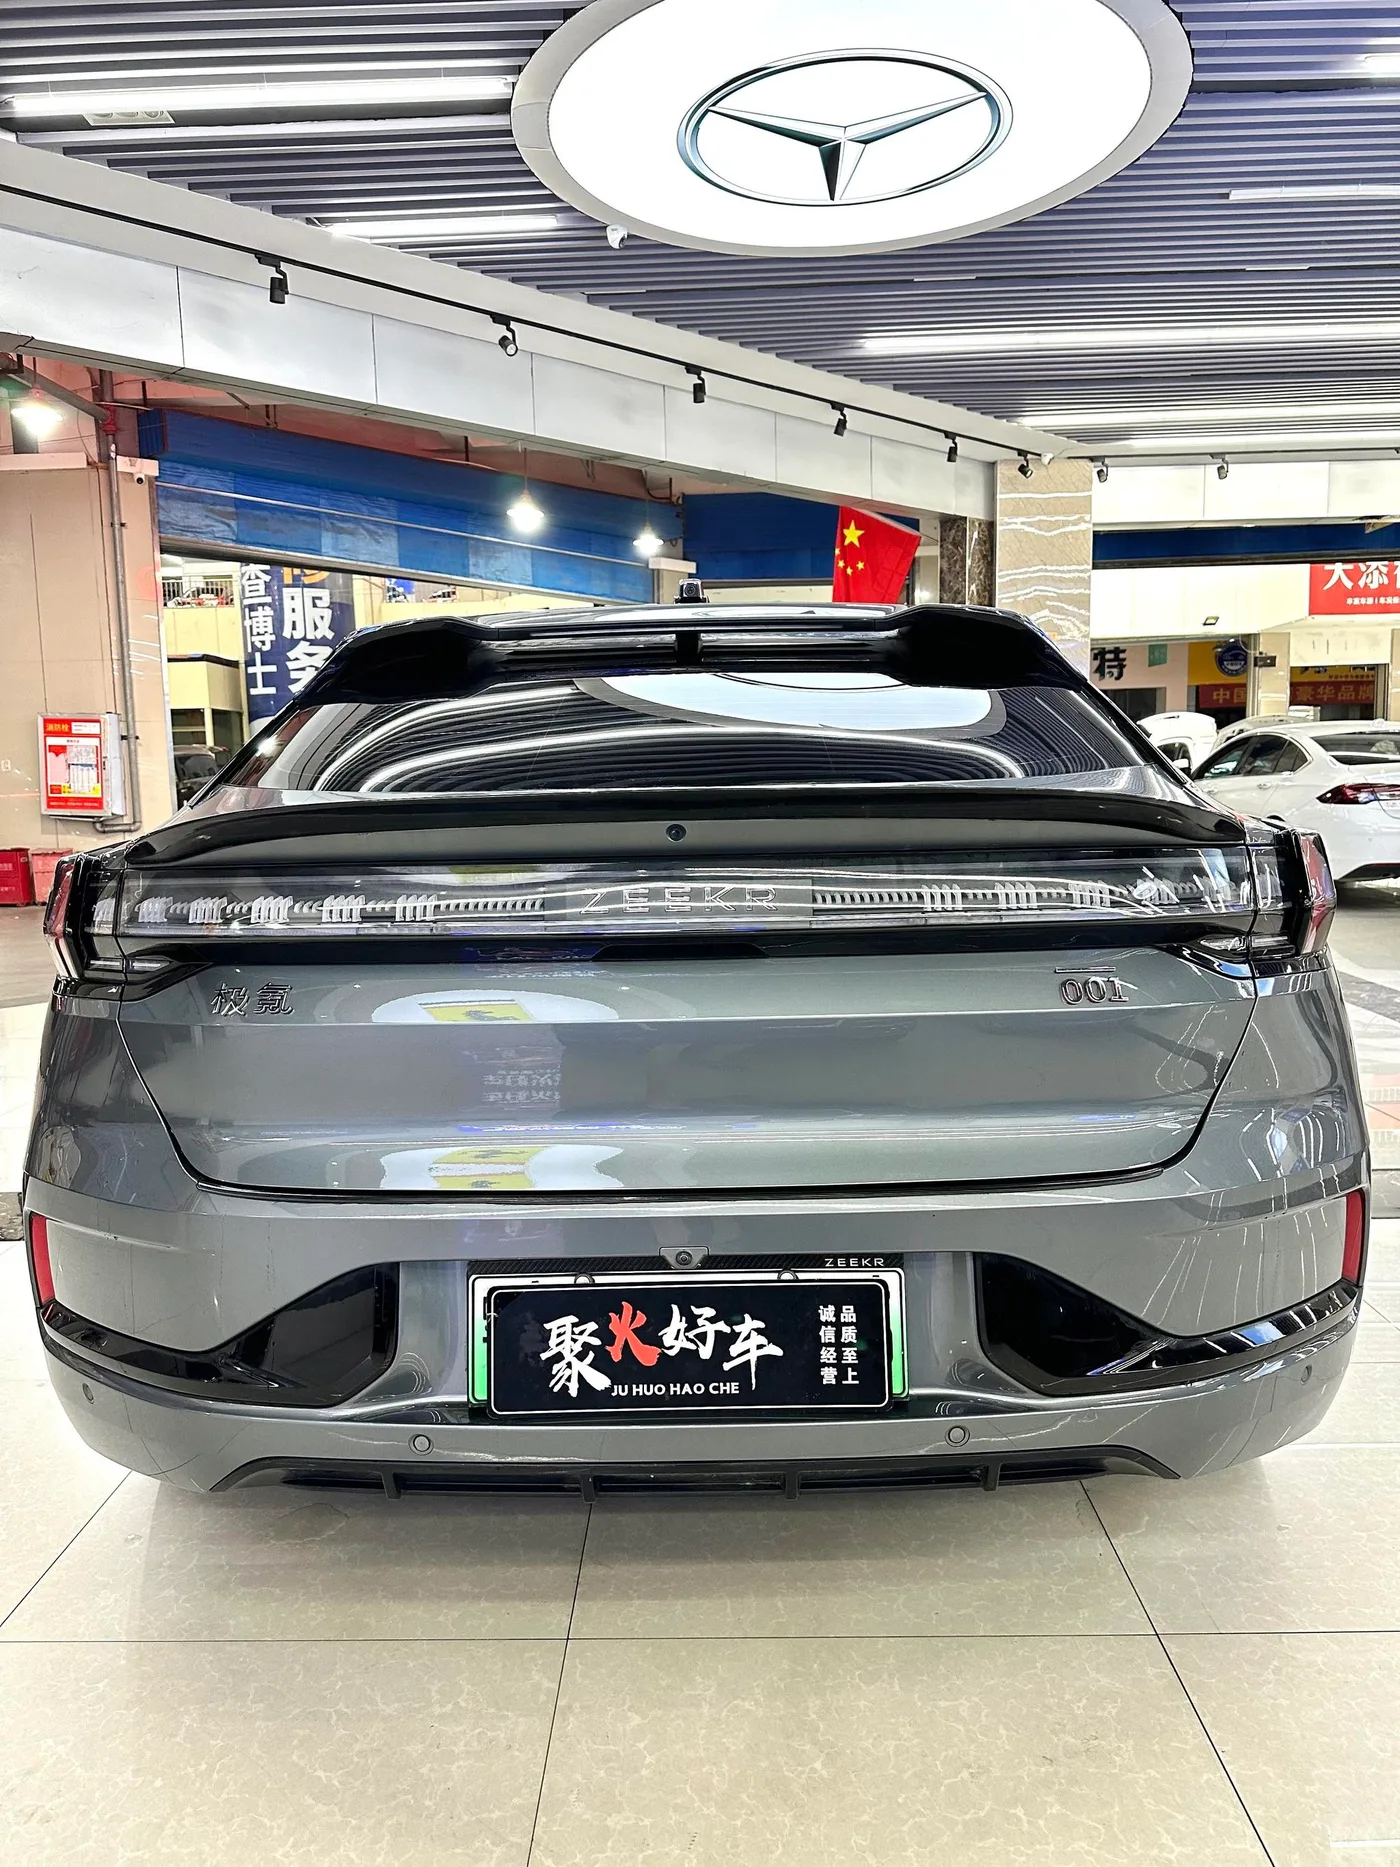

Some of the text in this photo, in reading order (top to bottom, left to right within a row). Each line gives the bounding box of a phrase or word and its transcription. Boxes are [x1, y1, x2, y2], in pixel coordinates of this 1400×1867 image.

[241, 564, 277, 695] 查博士
[580, 886, 778, 915] ZEEKR
[210, 982, 294, 1016] 极氪
[1060, 976, 1130, 1006] 001
[825, 1257, 885, 1267] ZEEKR
[540, 1301, 783, 1397] 聚火好车
[818, 1305, 838, 1385] 诚信经营
[840, 1305, 860, 1385] 品质至上
[611, 1382, 740, 1396] JU HUO HAO CHE
